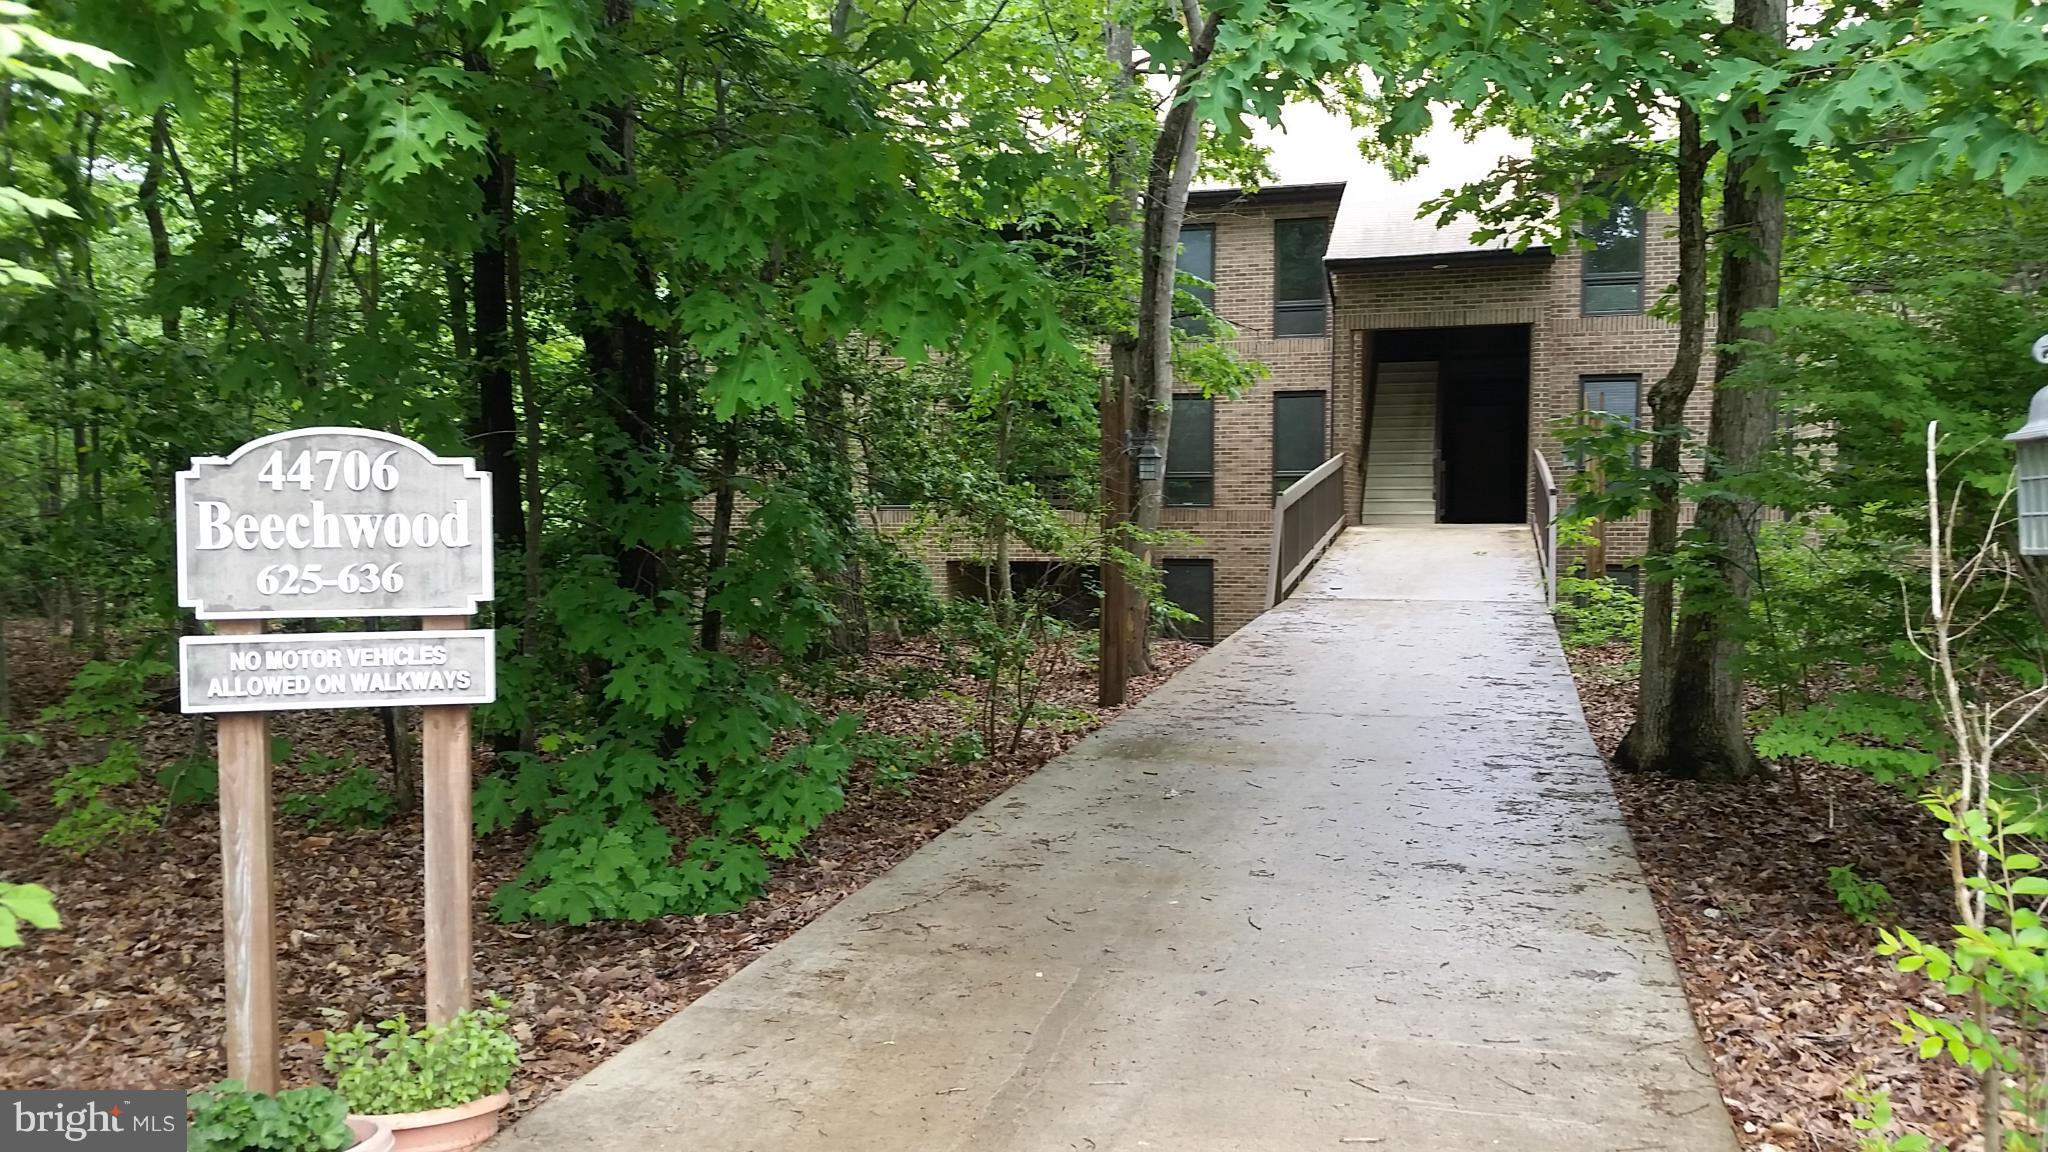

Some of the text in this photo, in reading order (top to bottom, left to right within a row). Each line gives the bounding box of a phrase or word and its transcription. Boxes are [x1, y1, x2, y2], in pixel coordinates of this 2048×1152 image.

[258, 450, 400, 491] 44706
[194, 500, 472, 550] Beechwood
[256, 562, 404, 595] 625-636
[230, 645, 448, 671] NO MOTOR VEHICLES
[207, 670, 472, 697] ALLOWED ON WALKWAYS
